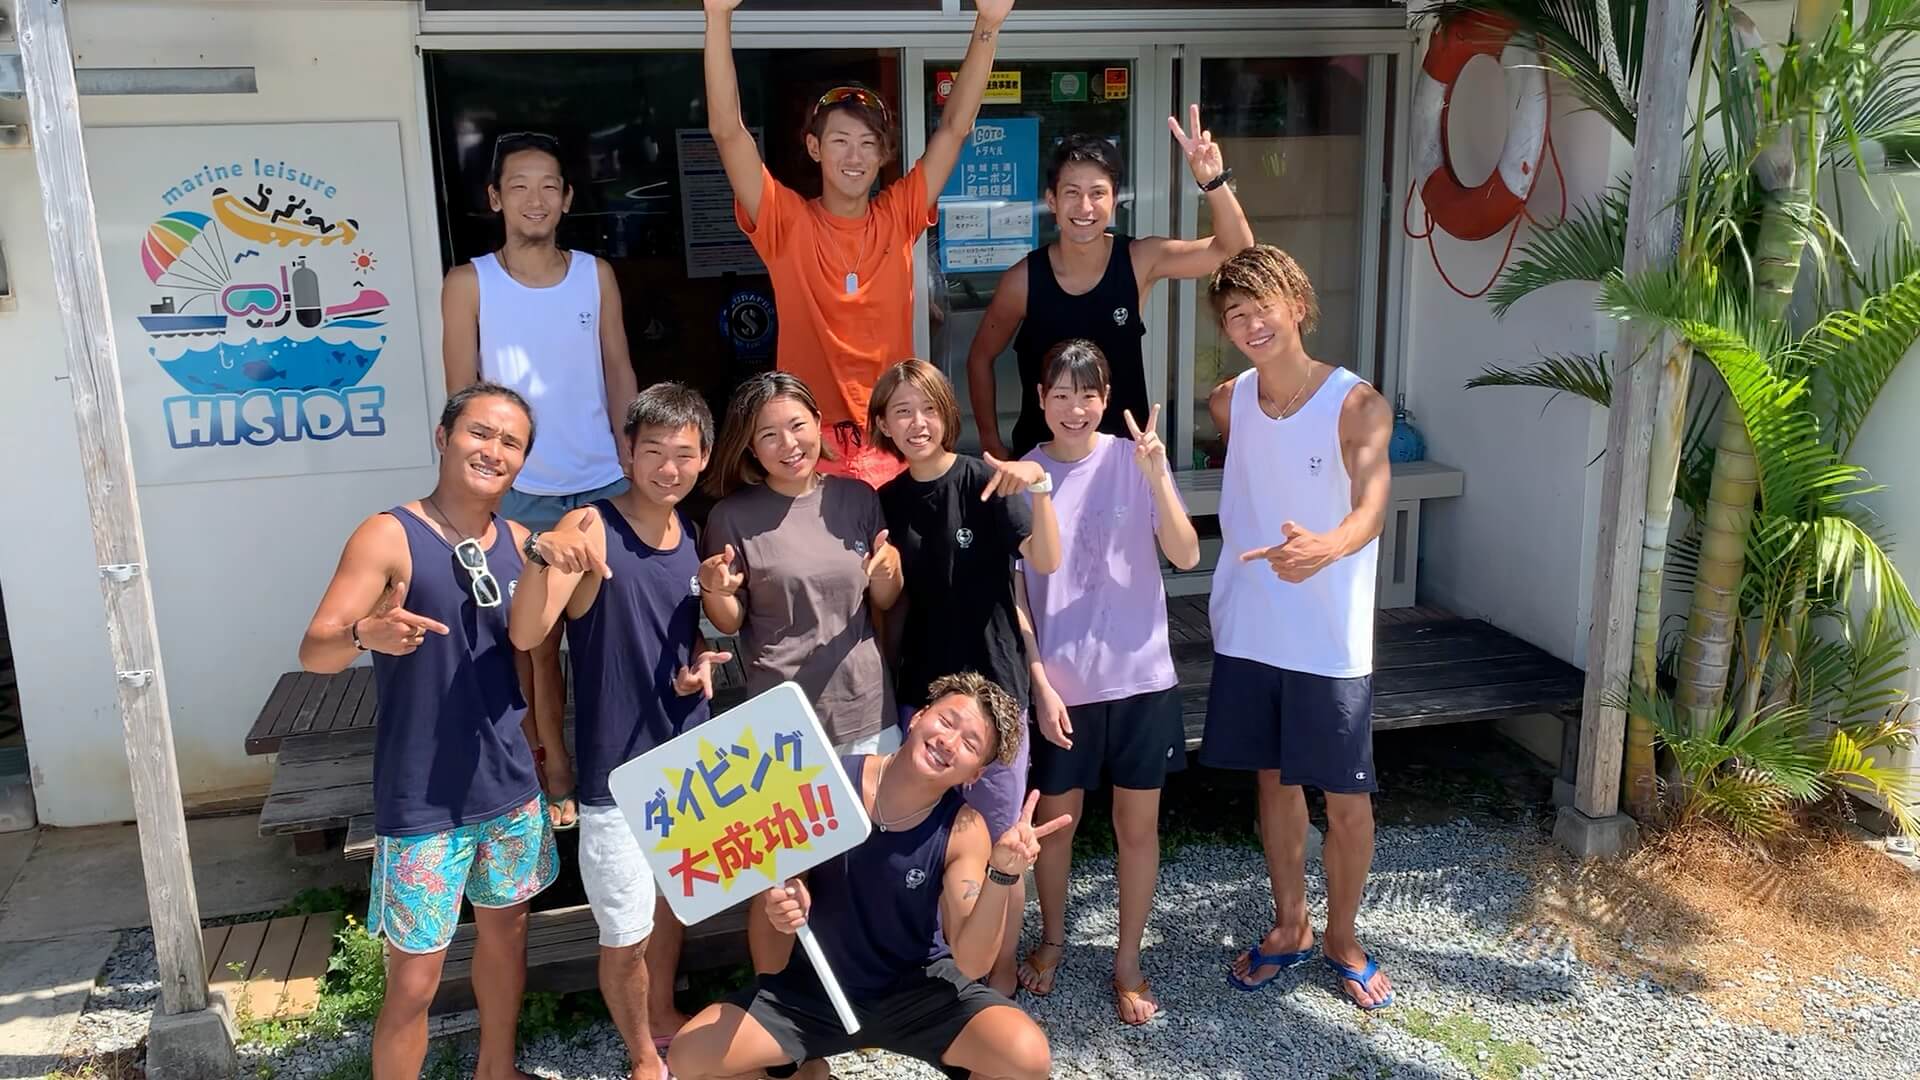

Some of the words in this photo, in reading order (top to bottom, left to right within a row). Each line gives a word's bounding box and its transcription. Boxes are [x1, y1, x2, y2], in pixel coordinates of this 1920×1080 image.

[967, 172, 1012, 184] クーポン
[975, 146, 1003, 156] トラベル
[162, 160, 243, 206] marine
[253, 158, 338, 200] leisure
[164, 387, 385, 449] HISIDE
[644, 729, 804, 838] ダイビング
[668, 783, 839, 897] 大成功!!
